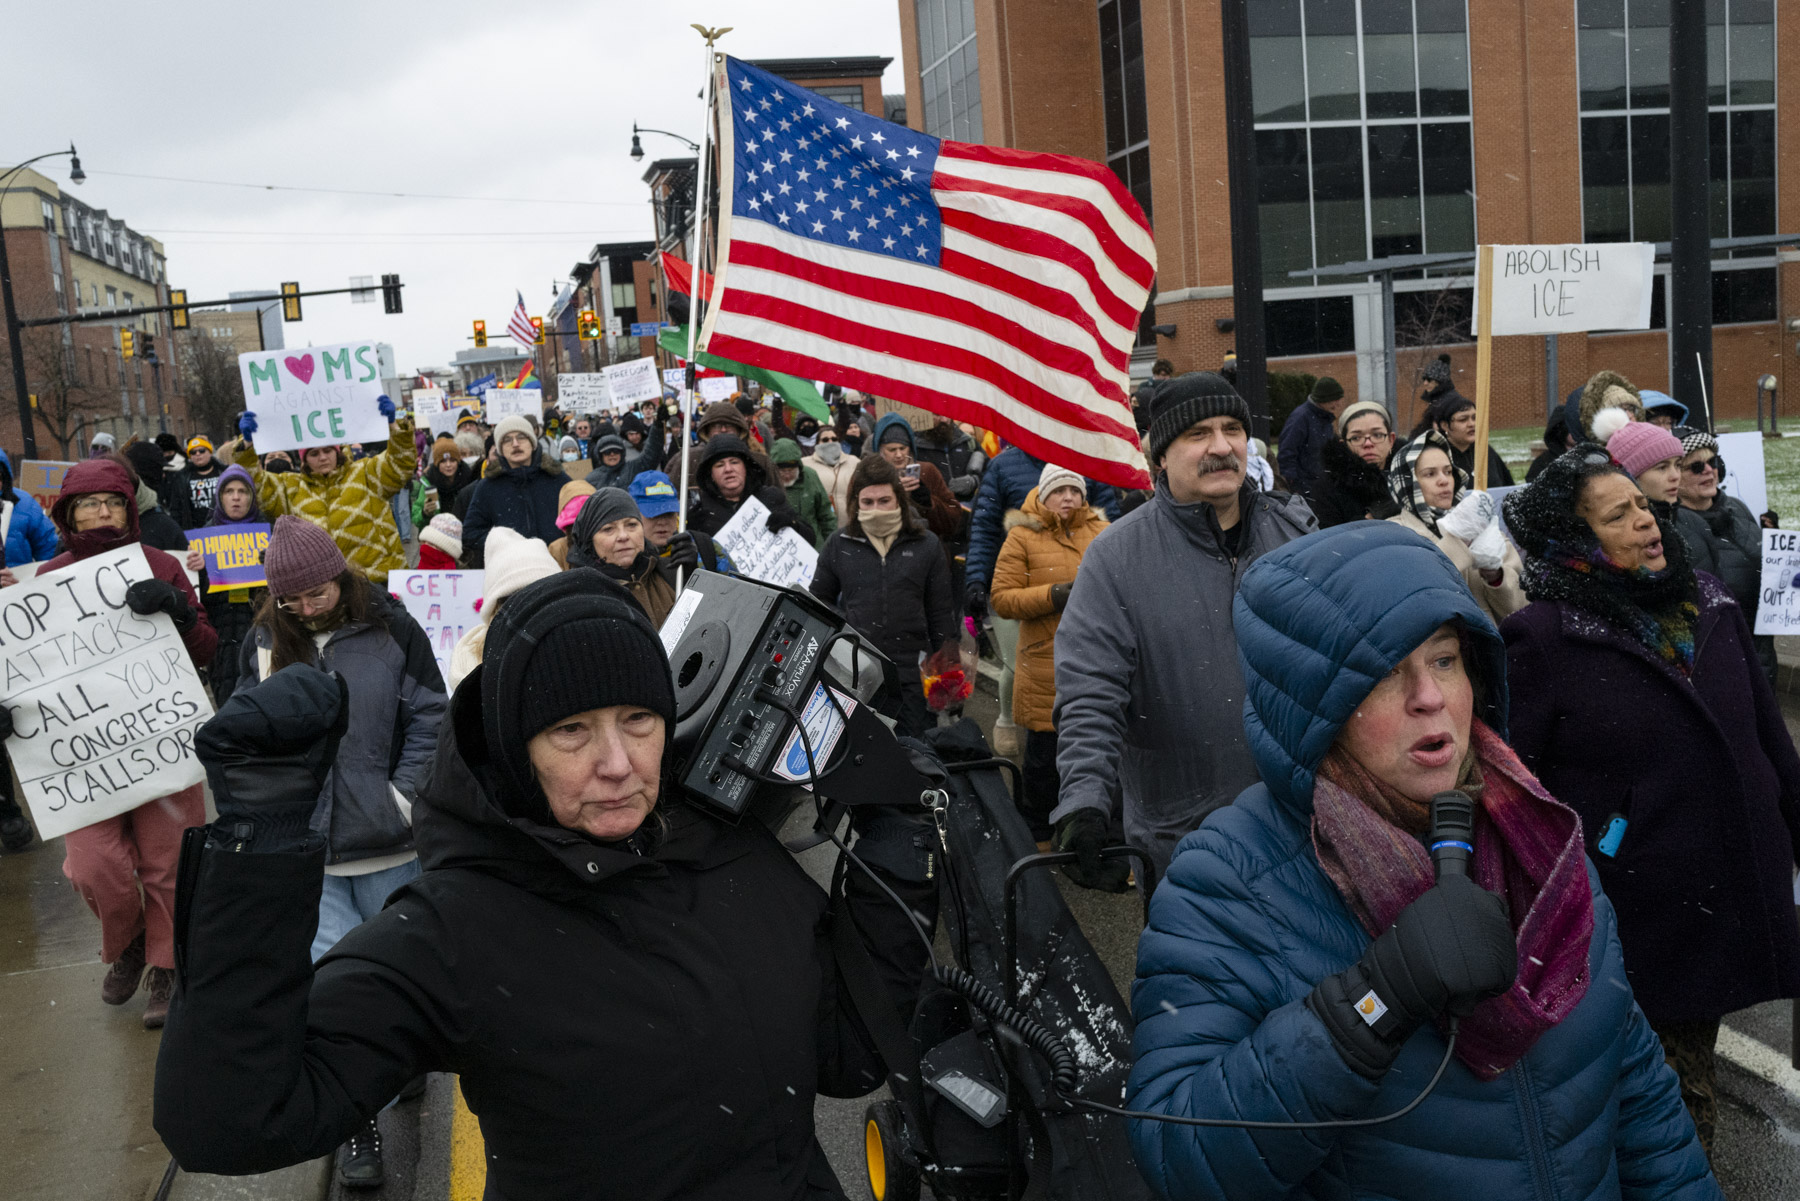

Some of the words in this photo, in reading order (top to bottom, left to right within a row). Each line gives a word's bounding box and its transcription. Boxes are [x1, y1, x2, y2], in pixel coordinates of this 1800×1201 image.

[1505, 248, 1600, 278] ABOLISH
[1533, 279, 1580, 319] ICE
[609, 365, 649, 380] FREEDOM
[273, 385, 355, 412] AGAINST
[291, 408, 345, 442] ICE
[204, 532, 255, 555] HUMAN
[255, 532, 269, 549] IS
[1770, 534, 1796, 551] ICE
[216, 548, 264, 570] ILLEGA
[1766, 557, 1783, 566] our
[406, 574, 463, 597] GET
[1763, 588, 1785, 606] OUT
[1786, 591, 1796, 606] of
[0, 593, 50, 645] OP
[427, 604, 441, 620] A
[6, 611, 158, 691] ATTACKS
[792, 644, 804, 662] POWER
[10, 684, 110, 740] CALL
[106, 647, 194, 700] YOUR
[51, 691, 198, 767] CONGRESS
[748, 752, 760, 768] STER
[731, 775, 747, 800] MPLIFIER
